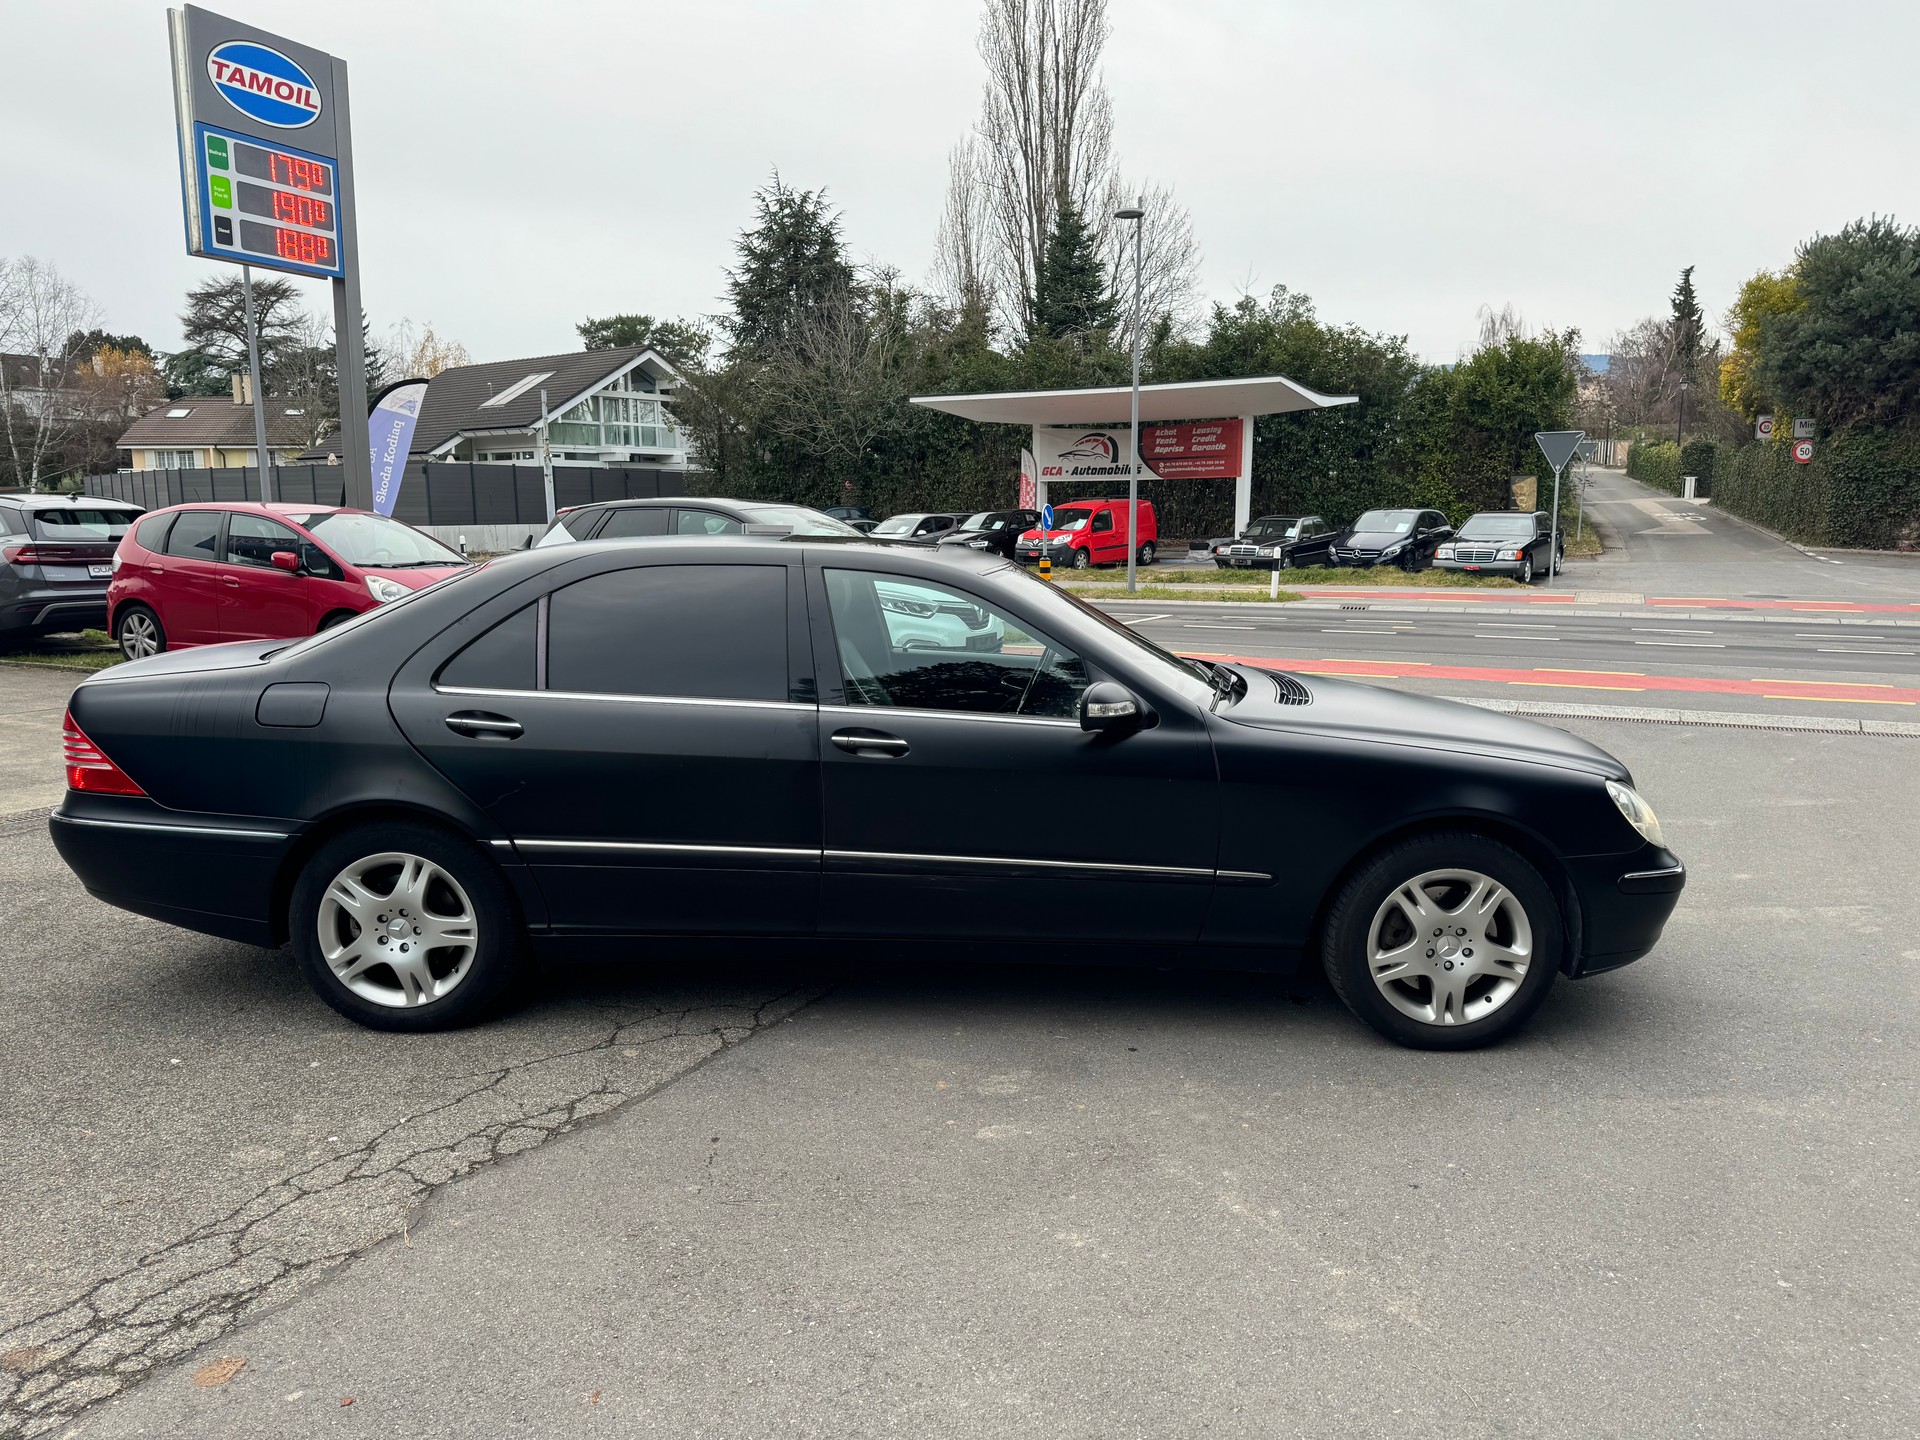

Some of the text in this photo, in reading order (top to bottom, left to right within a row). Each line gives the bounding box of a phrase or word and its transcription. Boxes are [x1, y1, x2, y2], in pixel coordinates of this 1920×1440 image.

[212, 60, 318, 110] TAMOIL
[1800, 421, 1815, 429] Mie
[1191, 426, 1222, 435] Leasing
[1191, 434, 1217, 442] Credit
[1154, 442, 1226, 454] Reprise Garantie
[1800, 448, 1810, 456] 50
[376, 420, 405, 503] Skoda Kodiaq
[1042, 463, 1142, 476] GCA Automobils
